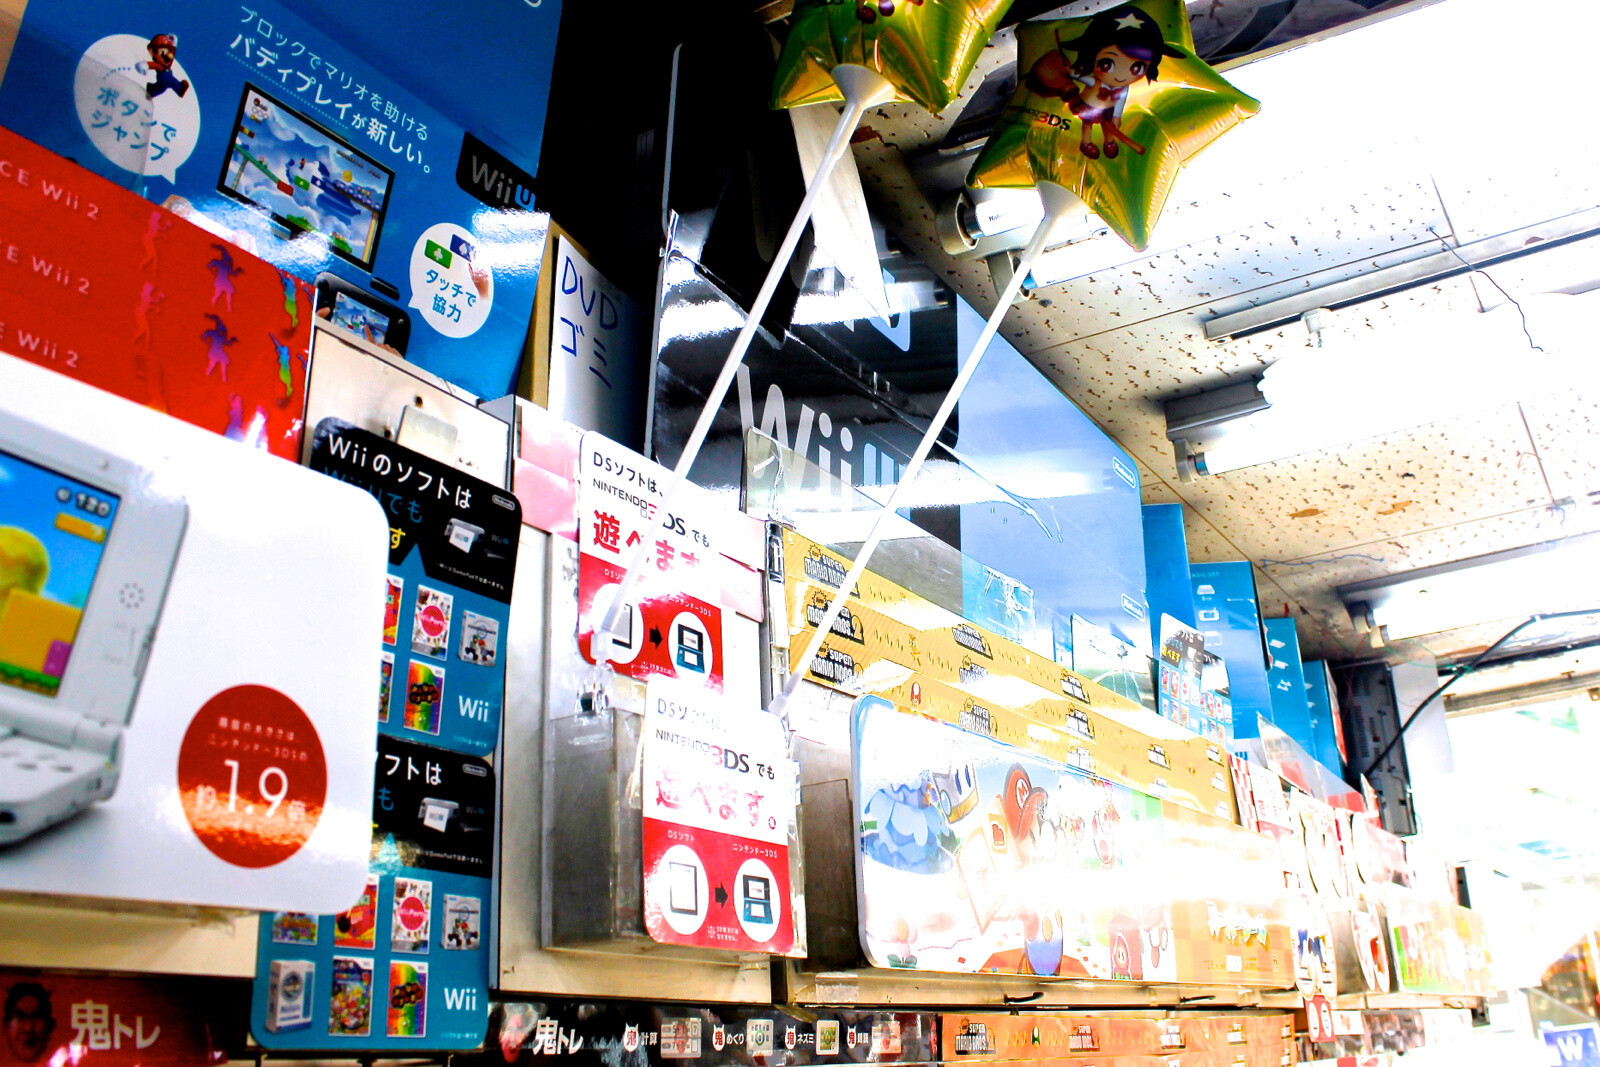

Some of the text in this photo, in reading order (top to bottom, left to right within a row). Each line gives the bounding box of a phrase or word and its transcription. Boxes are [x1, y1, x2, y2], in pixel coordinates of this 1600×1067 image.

[240, 5, 428, 141] ブロックでマリオを助ける
[97, 87, 177, 142] ボタンで
[230, 34, 430, 173] バディプレイが新しい。
[1037, 112, 1072, 131] 3DS
[91, 110, 170, 161] ジャンプ
[472, 154, 513, 204] Wii
[42, 180, 79, 209] Wii
[87, 203, 99, 220] 2
[32, 256, 70, 285] Wii
[78, 277, 90, 295] 2
[426, 269, 477, 307] タッチで
[562, 255, 618, 330] DVD
[431, 294, 462, 323] 協力
[18, 329, 57, 359] Wii
[66, 350, 78, 368] 2
[328, 433, 472, 509] Wiiのソフトは
[593, 451, 664, 498] DSソフトは、
[458, 695, 489, 722] Wii
[378, 752, 442, 786] フトは
[711, 744, 750, 774] 3DS
[756, 763, 775, 780] でも
[667, 830, 695, 842] DSソフト
[732, 843, 778, 859] ニンテンドー3DS
[443, 988, 477, 1011] Wii
[69, 1000, 161, 1050] 鬼トレ
[533, 1017, 584, 1055] 鬼トレ
